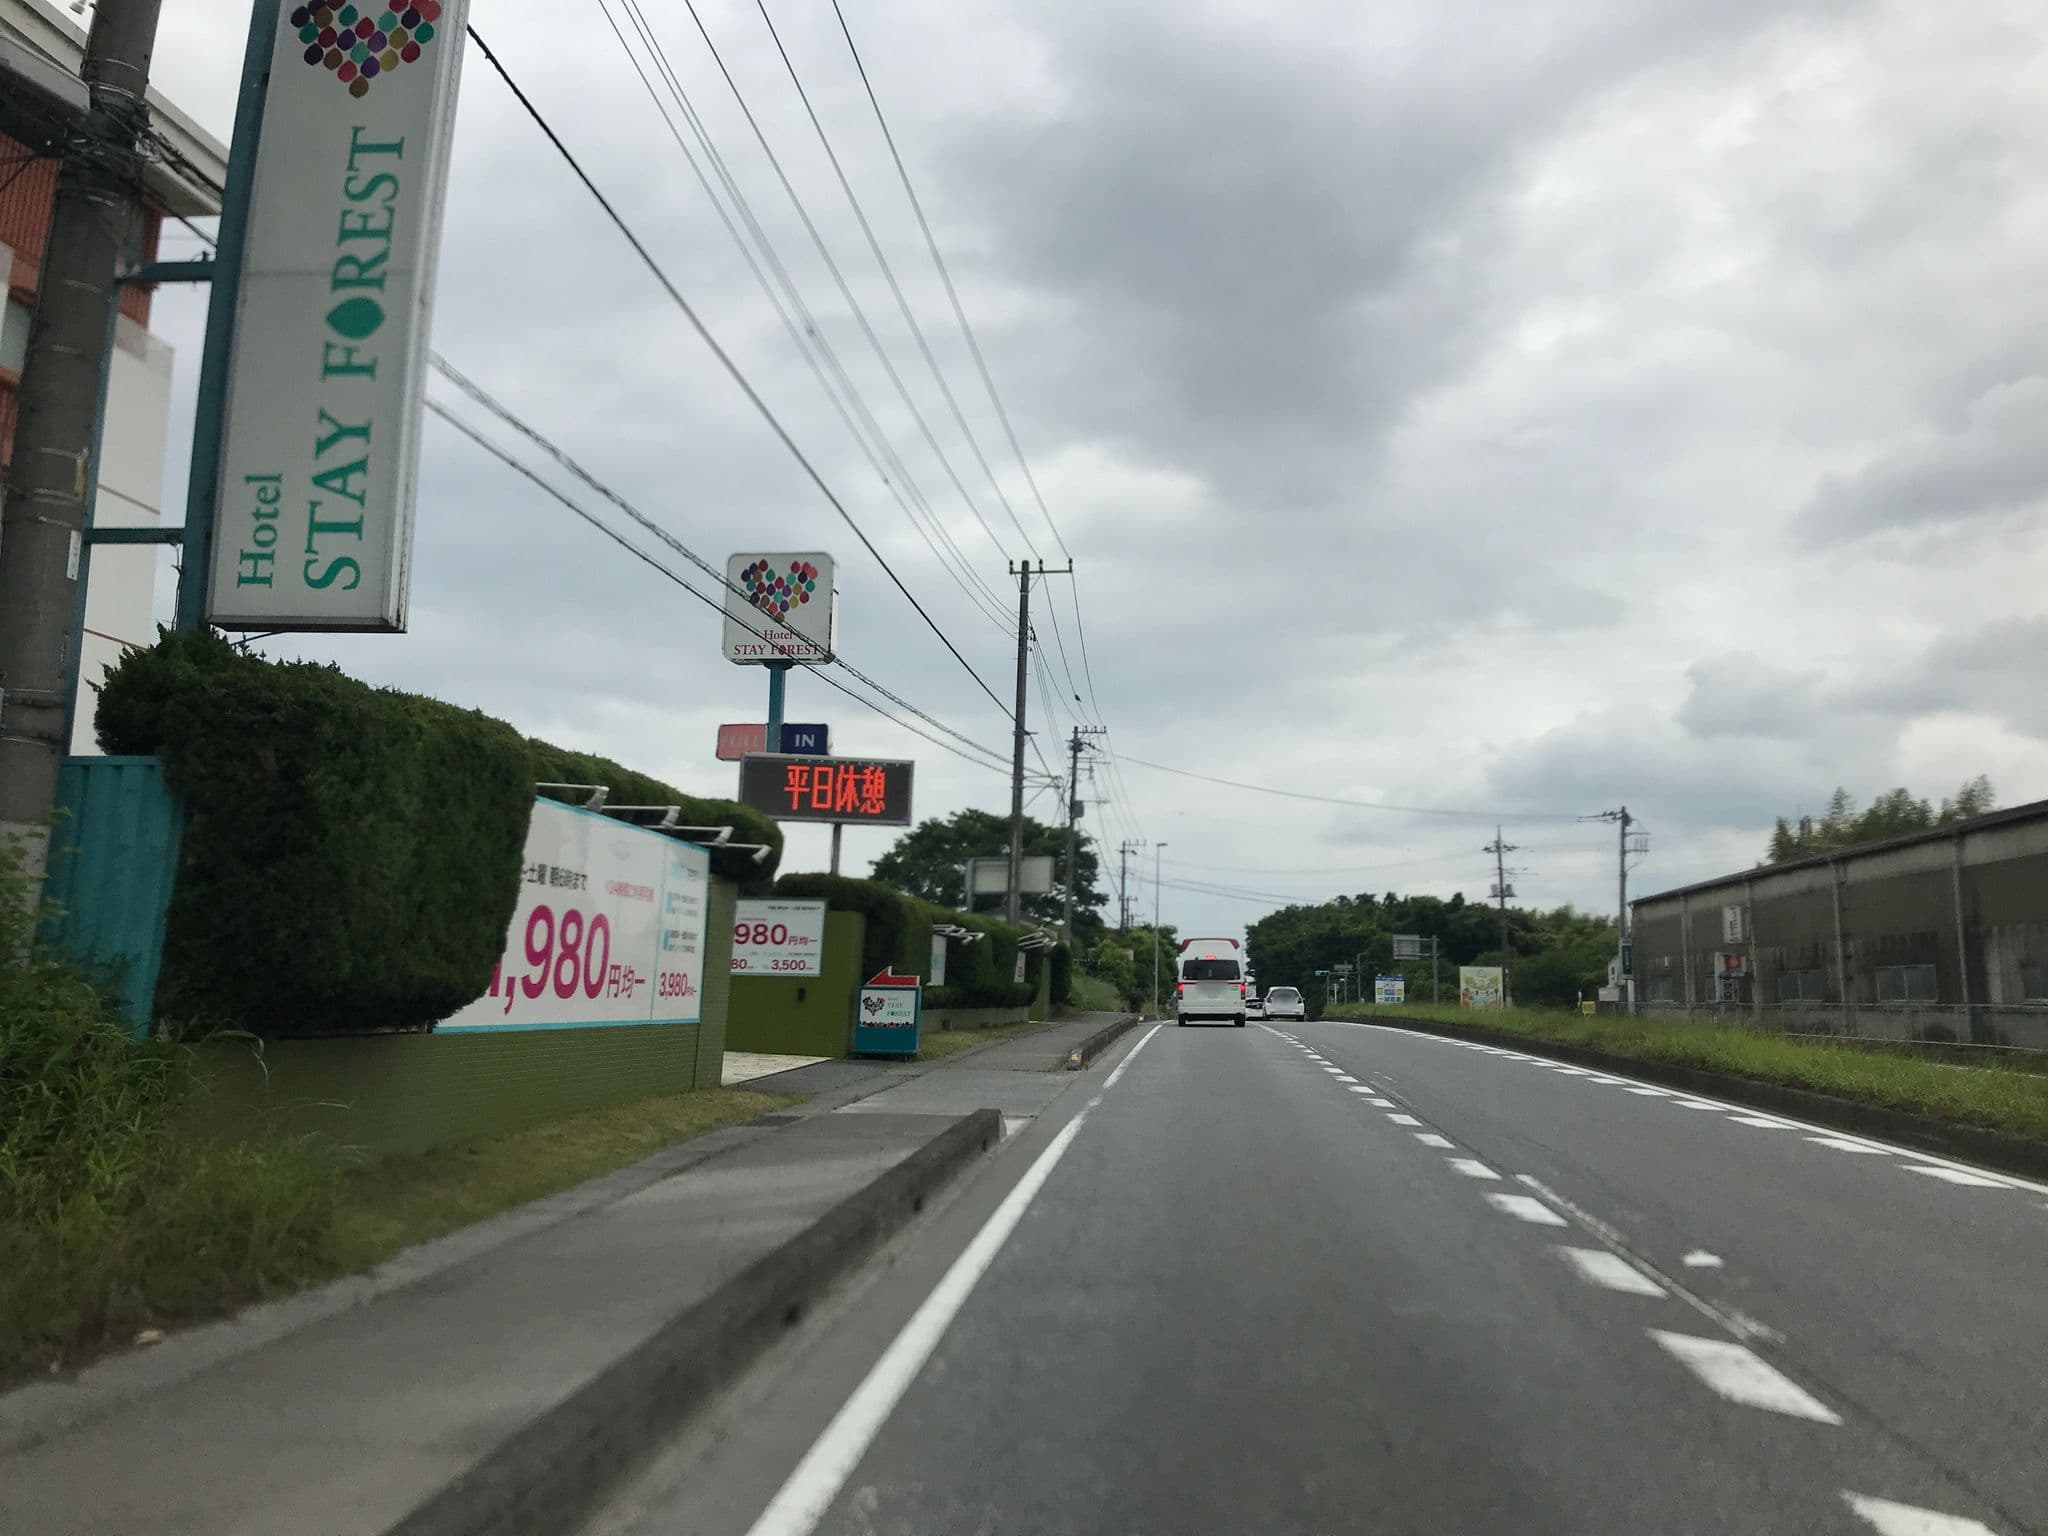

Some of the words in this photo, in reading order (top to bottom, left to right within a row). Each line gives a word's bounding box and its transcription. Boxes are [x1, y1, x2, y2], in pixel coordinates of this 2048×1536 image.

[321, 125, 405, 382] FOREST
[303, 407, 372, 591] STAY
[236, 472, 283, 589] Hotel
[734, 644, 766, 656] STAY
[771, 644, 819, 656] FOREST
[764, 629, 793, 640] Hotel
[794, 733, 815, 748] IN
[784, 764, 886, 815] 平日休憩
